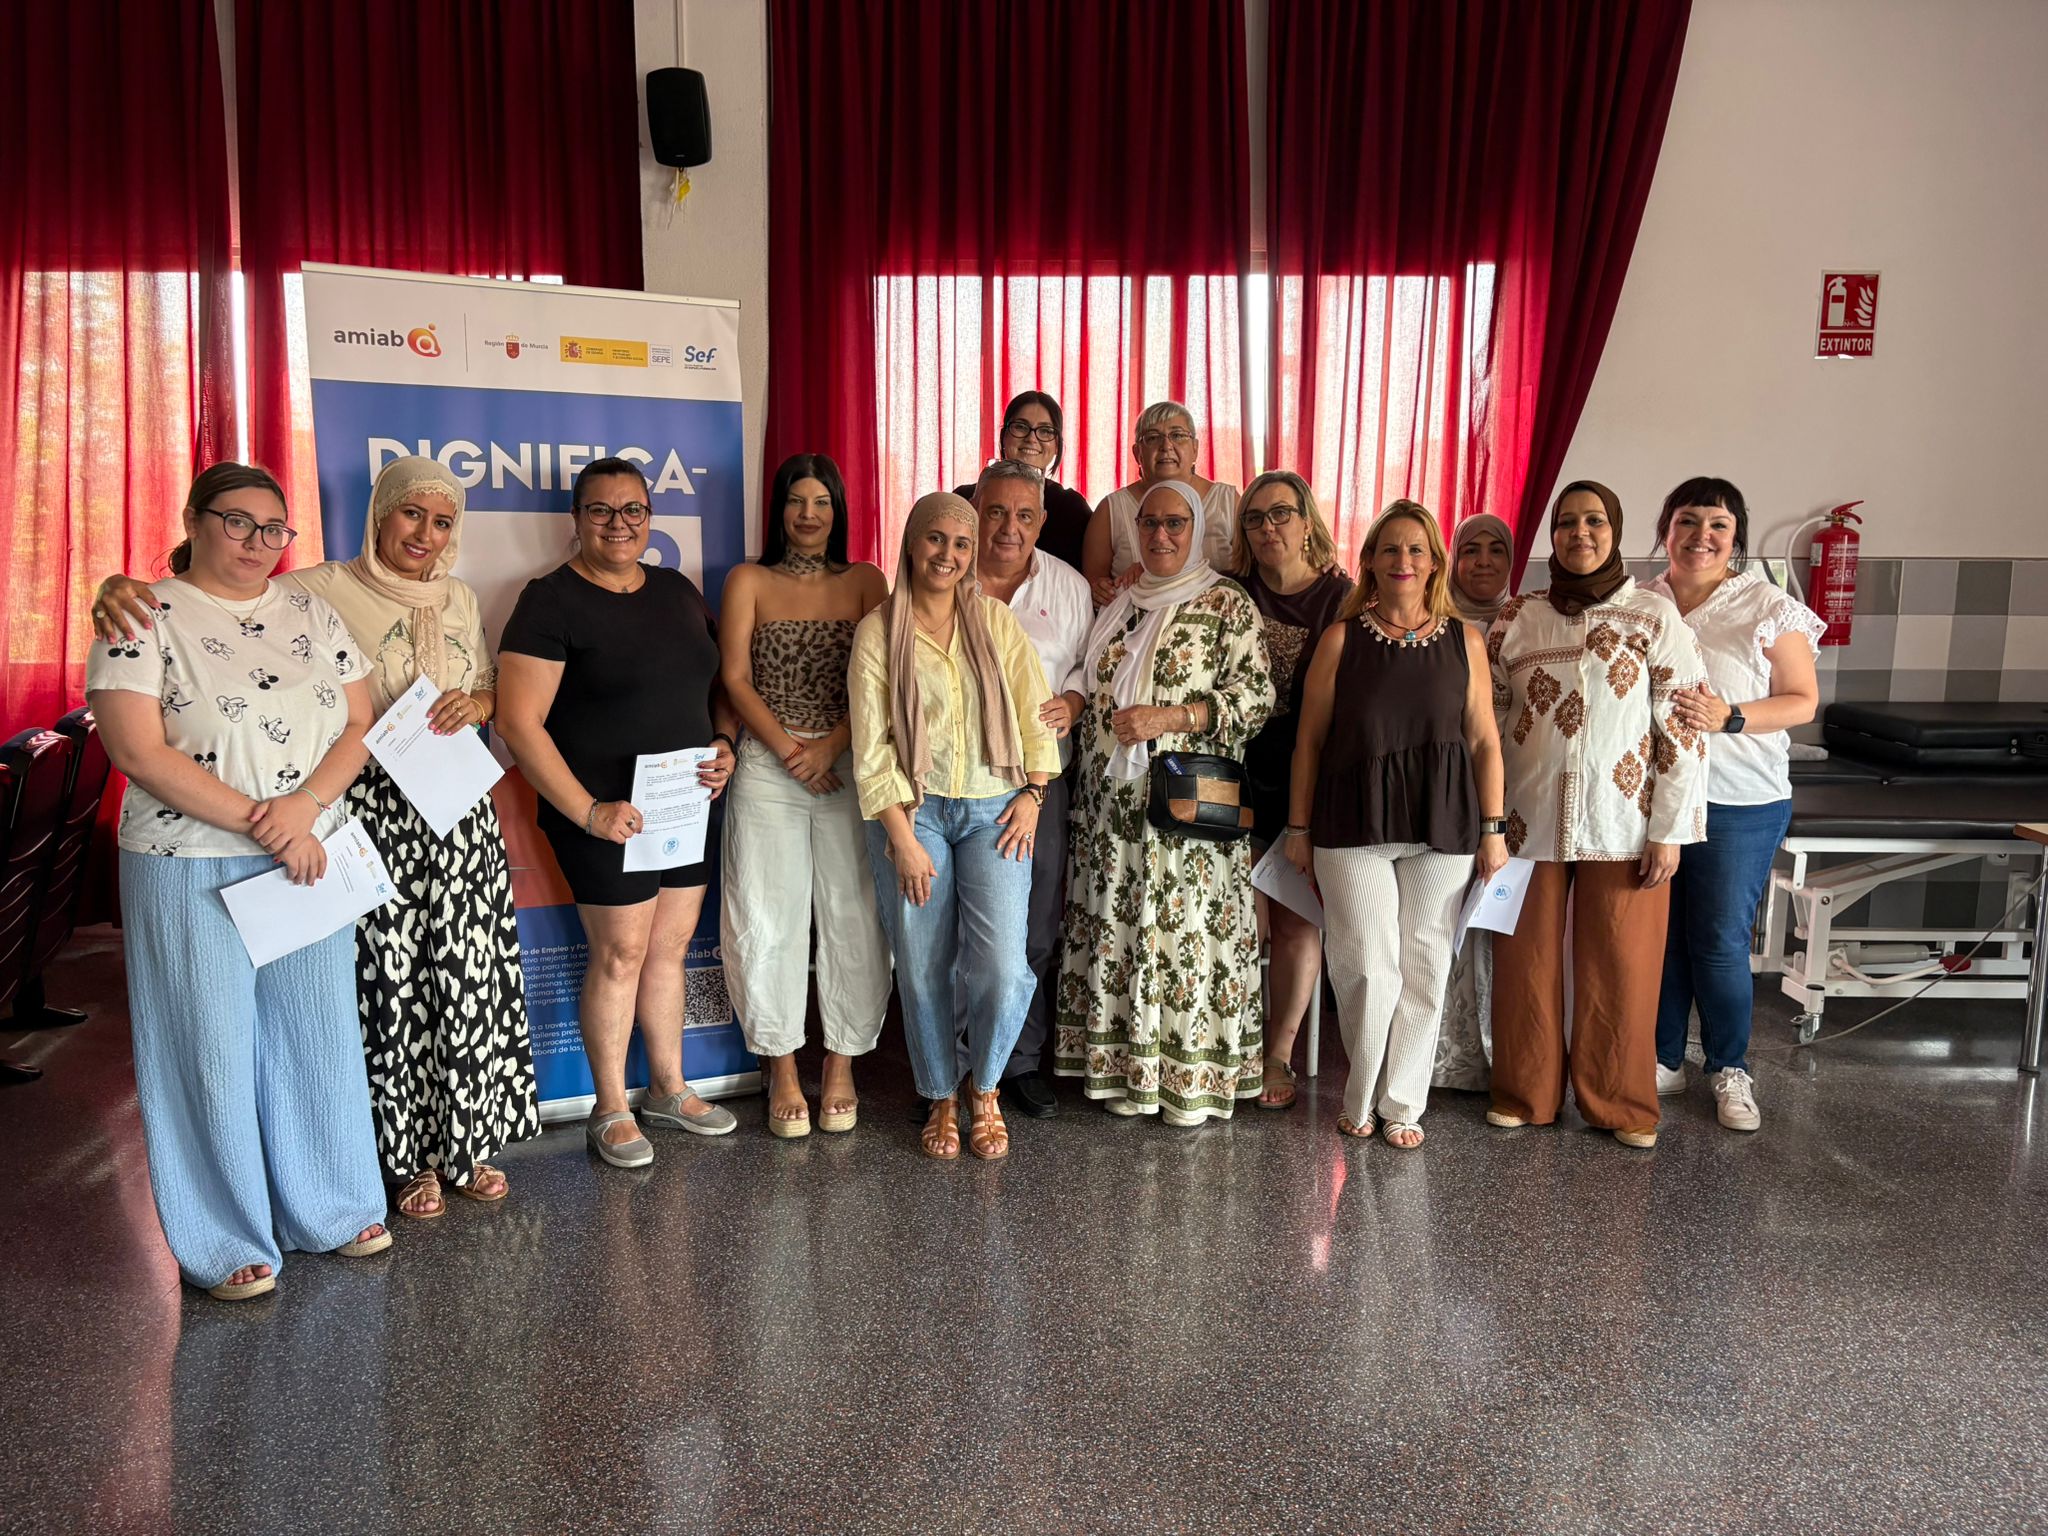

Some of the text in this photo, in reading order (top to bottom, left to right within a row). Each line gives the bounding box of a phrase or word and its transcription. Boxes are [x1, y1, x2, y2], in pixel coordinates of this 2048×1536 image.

[334, 328, 404, 347] amiab
[1820, 338, 1871, 351] EXTINTOR
[652, 355, 671, 363] SEPE
[684, 345, 717, 363] Sef
[368, 437, 707, 495] DGNIFCA-
[530, 947, 540, 955] de
[541, 945, 569, 954] Empleo
[540, 953, 568, 963] mejorar
[542, 964, 560, 972] para
[523, 972, 556, 981] odemos
[528, 980, 563, 990] personas
[532, 996, 569, 1007] migrantes
[544, 1020, 568, 1030] través
[532, 1031, 560, 1040] talleres
[542, 1037, 573, 1049] proceso
[558, 1045, 569, 1053] de
[569, 1044, 581, 1052] las
